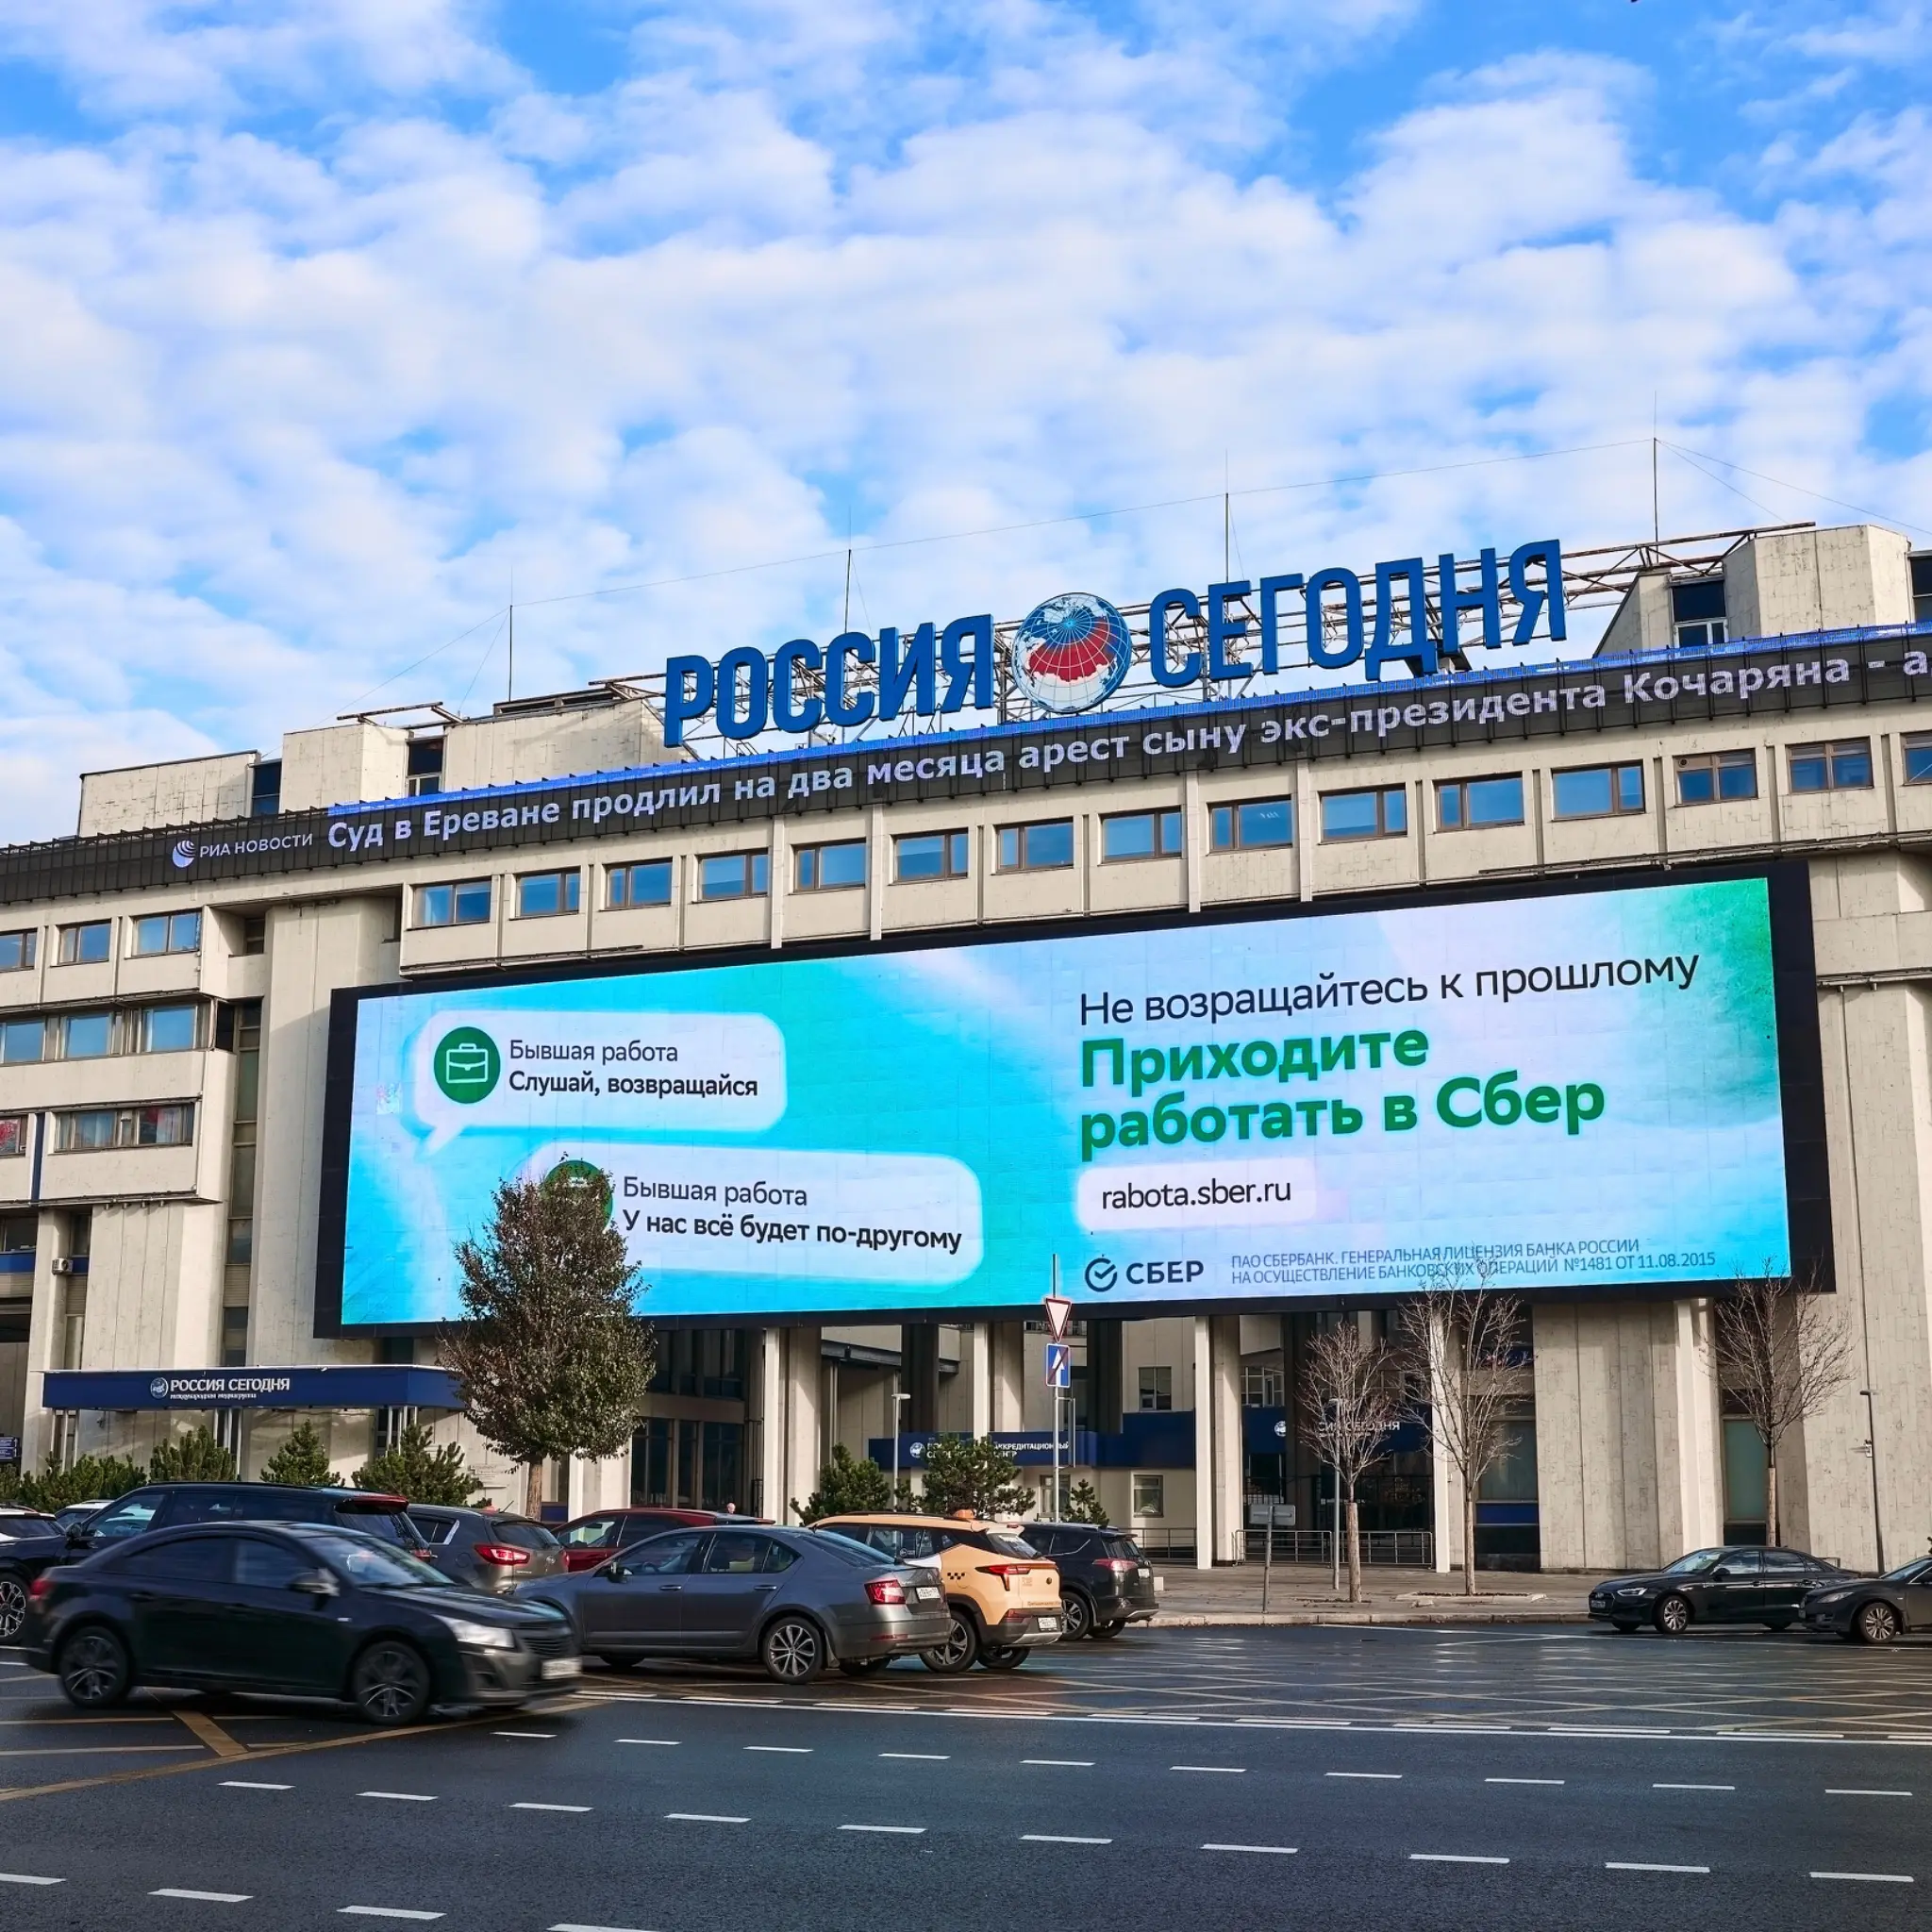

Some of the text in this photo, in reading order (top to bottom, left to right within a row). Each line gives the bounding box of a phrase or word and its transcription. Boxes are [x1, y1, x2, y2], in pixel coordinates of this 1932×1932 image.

[664, 539, 1567, 748] РОССИЯ СЕГОДНЯ
[328, 822, 383, 852] Суд
[395, 818, 411, 841] в
[424, 802, 559, 841] Ереване
[572, 782, 721, 824] продлил
[734, 775, 775, 800] на
[788, 765, 853, 798] два
[867, 749, 1006, 787] месяца
[1019, 736, 1130, 773] арест
[1142, 723, 1246, 755] сыну
[1260, 684, 1606, 743] экс-президента
[1624, 658, 1850, 704] Кочаряна
[200, 833, 312, 858] РИА НОВОСТИ
[1081, 954, 1699, 1025] Не возращайтесь к прошлому
[509, 1040, 679, 1066] Бывшая работа
[1081, 1029, 1429, 1096] Приходите
[508, 1071, 758, 1099] Слушай, возвращайся
[1081, 1071, 1605, 1161] работать в Сбер
[624, 1176, 808, 1207] Бывшая работа
[1101, 1178, 1292, 1210] rabota.sber.ru
[623, 1209, 962, 1255] У нас всё будет по-другому
[1231, 1239, 1640, 1269] ПАО СБЕРБАНК. ГЕНЕРАЛЬНАЯ ЛИЦЕНЗИЯ БАНКА РОССИИ
[1232, 1251, 1715, 1285] НА ОСУЩЕСТВЛЕНИЕ БАНКОВСКИХ ОПЕРАЦИЙ №1481 ОТ 11.08.2015
[1126, 1259, 1204, 1284] СБЕР
[170, 1377, 290, 1393] РОССИЯ СЕГОДНЯ
